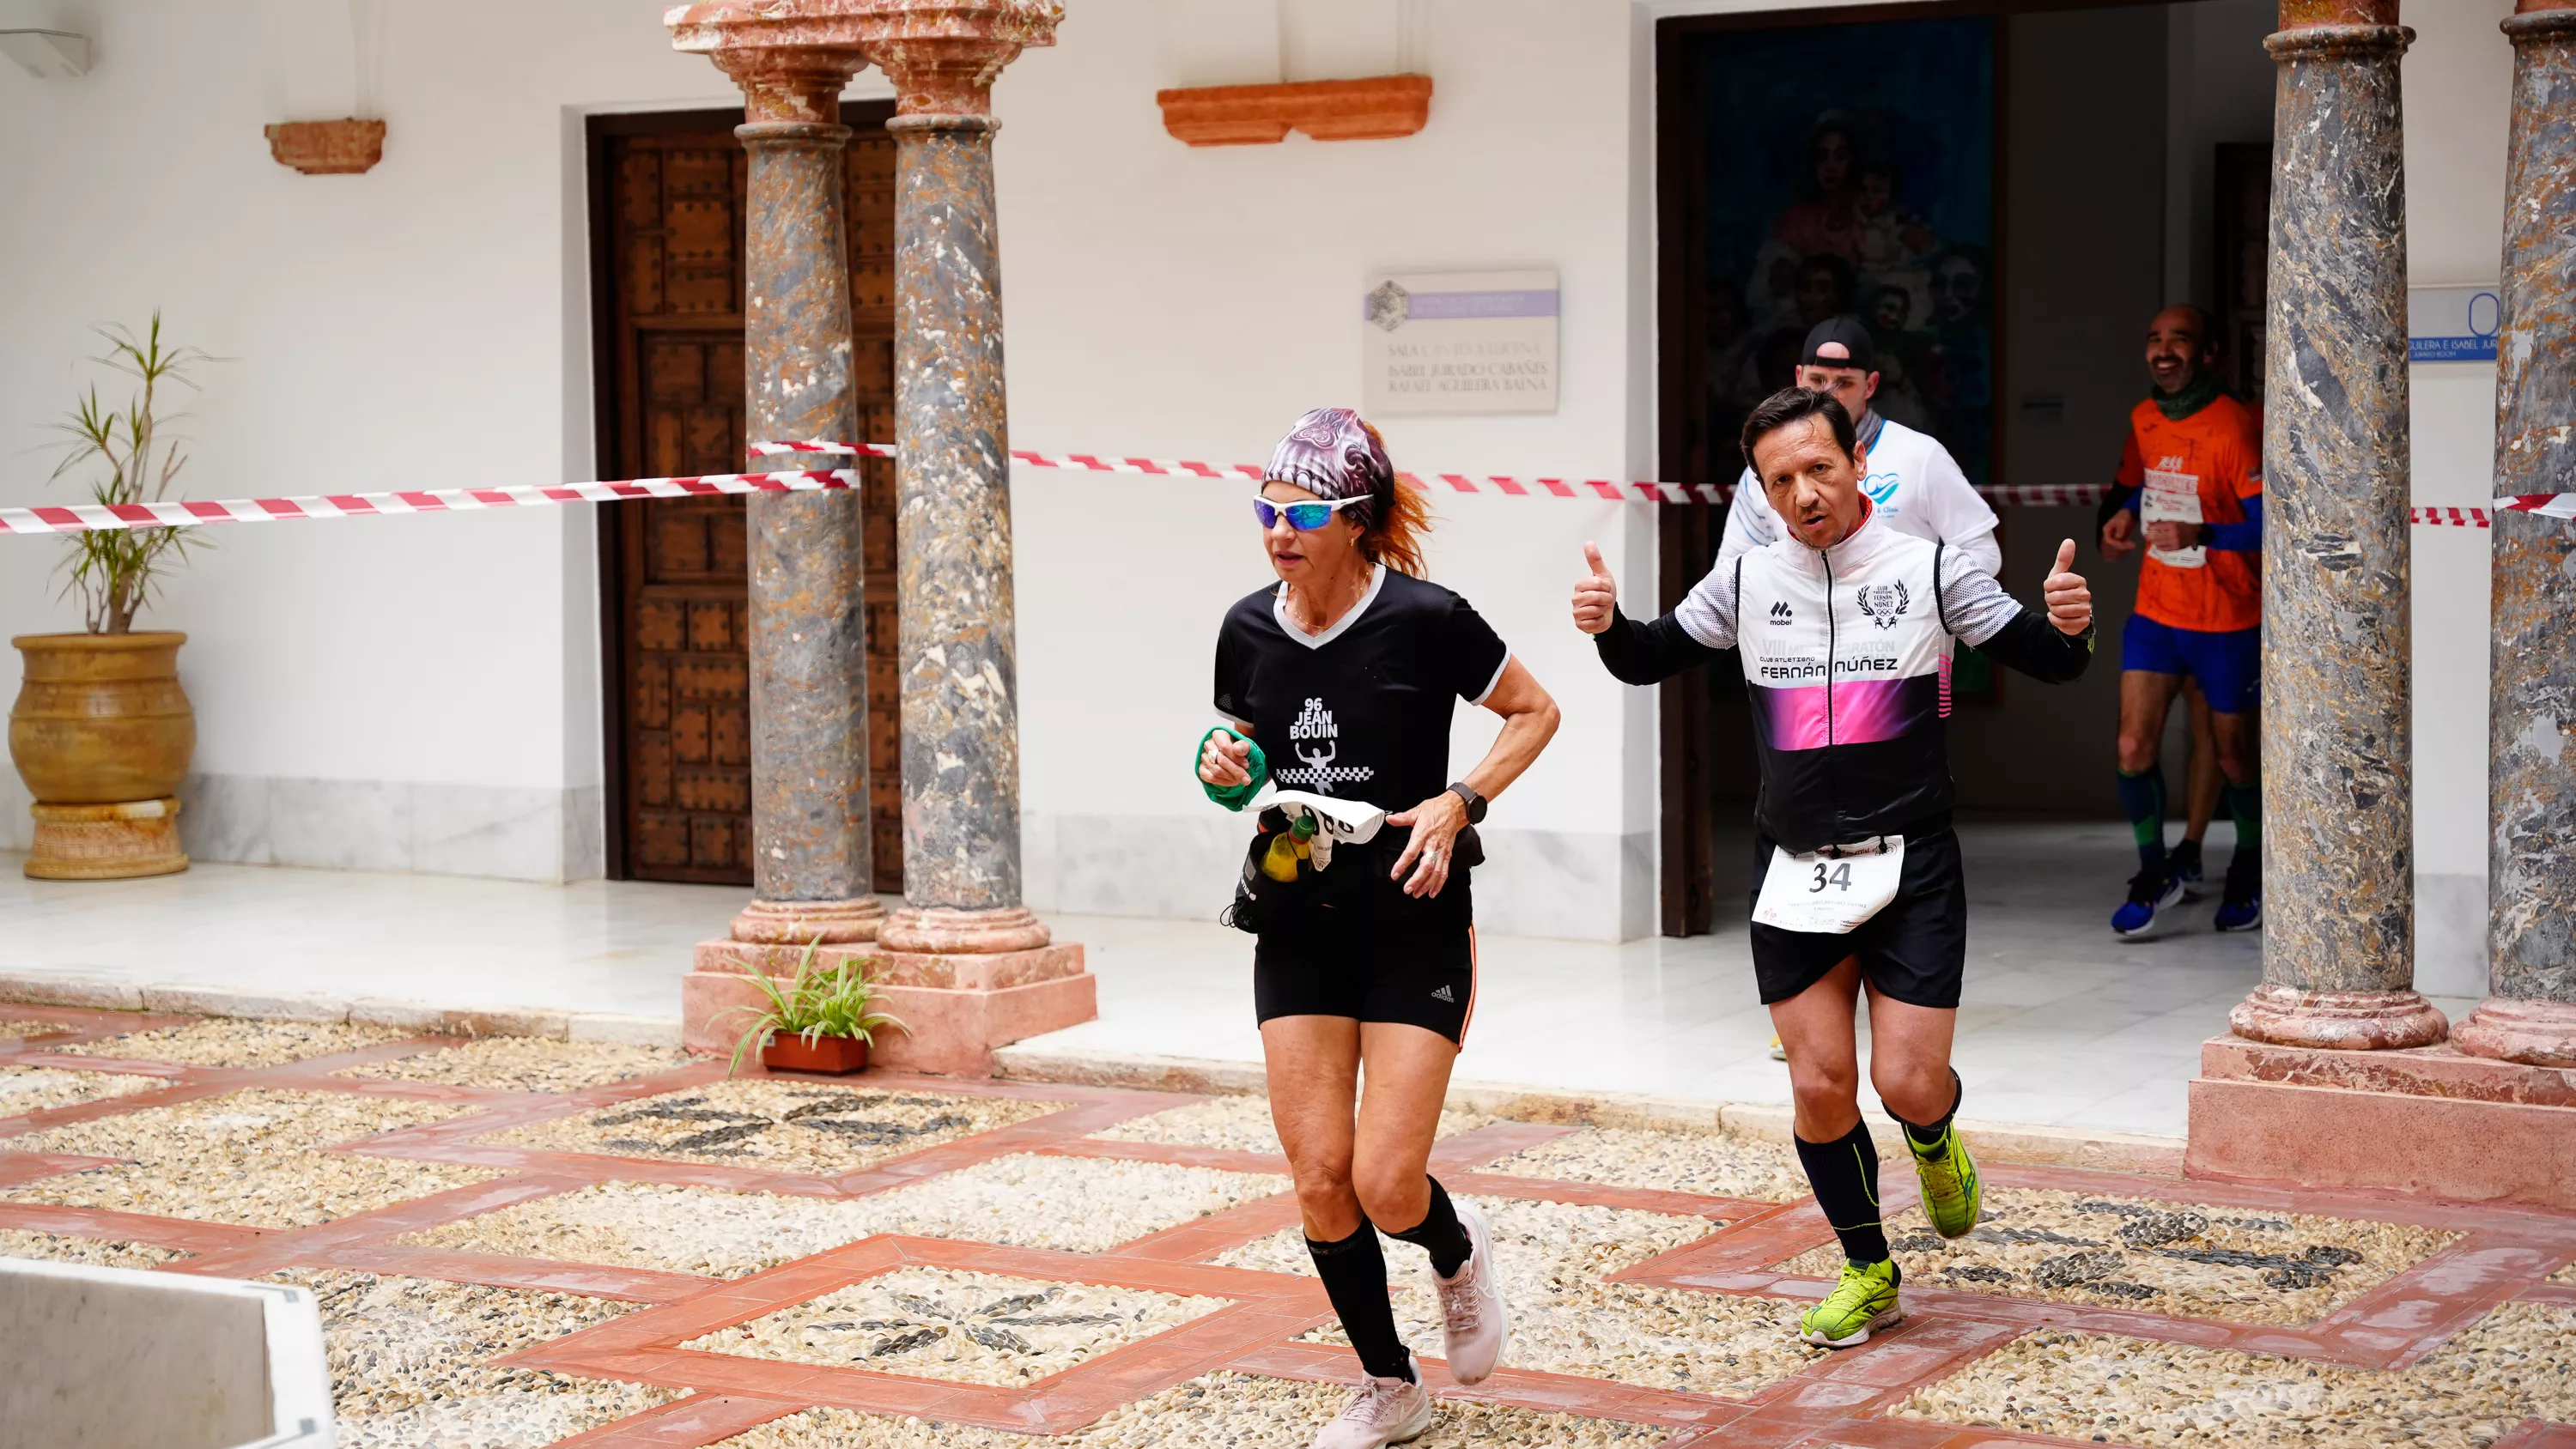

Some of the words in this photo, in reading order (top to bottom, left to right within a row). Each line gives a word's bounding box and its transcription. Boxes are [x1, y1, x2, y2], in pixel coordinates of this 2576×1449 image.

[2444, 340, 2449, 350] E
[2451, 339, 2479, 350] ISABEL
[1388, 362, 1426, 378] ISABEL
[1431, 361, 1486, 378] JURADO
[1387, 379, 1432, 393] RAFAEL
[1438, 379, 1501, 393] AGUILERA
[1503, 378, 1548, 392] BAENA
[1760, 662, 1826, 679] FERNÁN
[1834, 656, 1899, 673] NÚÑEZ
[1304, 697, 1323, 712] 96
[1294, 710, 1332, 726] JEAN
[1290, 724, 1339, 740] BOUIN
[1808, 863, 1852, 894] 34
[1431, 991, 1455, 1003] adidas
